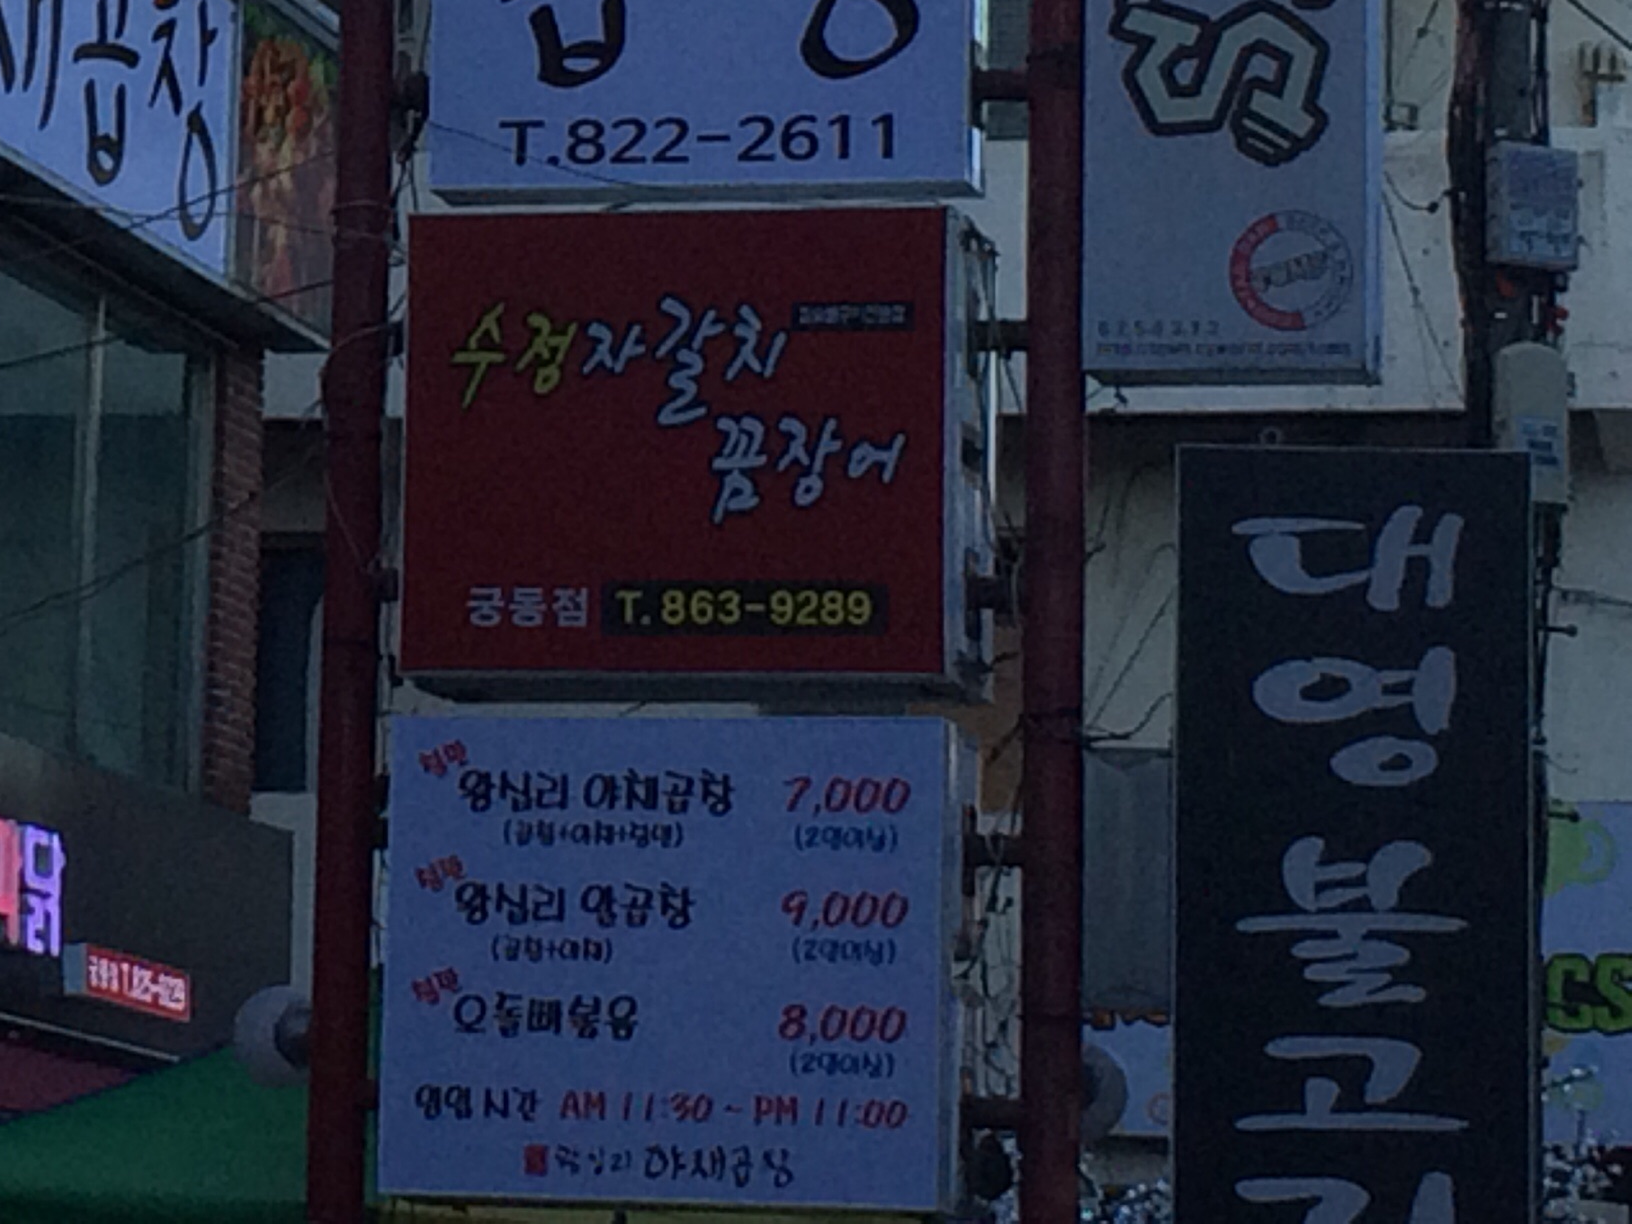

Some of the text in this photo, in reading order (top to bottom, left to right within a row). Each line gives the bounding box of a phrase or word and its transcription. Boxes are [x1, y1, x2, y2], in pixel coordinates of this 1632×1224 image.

[498, 112, 897, 167] T.822-2611
[709, 412, 909, 525] 꼼장어
[465, 585, 590, 630] 궁동점
[457, 767, 913, 818] 왕십리 야채곱창 7,000
[454, 880, 566, 928] 왕십리
[780, 888, 911, 931] 9,000
[777, 1002, 909, 1046] 8,000
[558, 1090, 607, 1121] AM
[623, 1091, 715, 1125] 11:30
[753, 1095, 800, 1125] PM
[814, 1098, 910, 1129] 11:00
